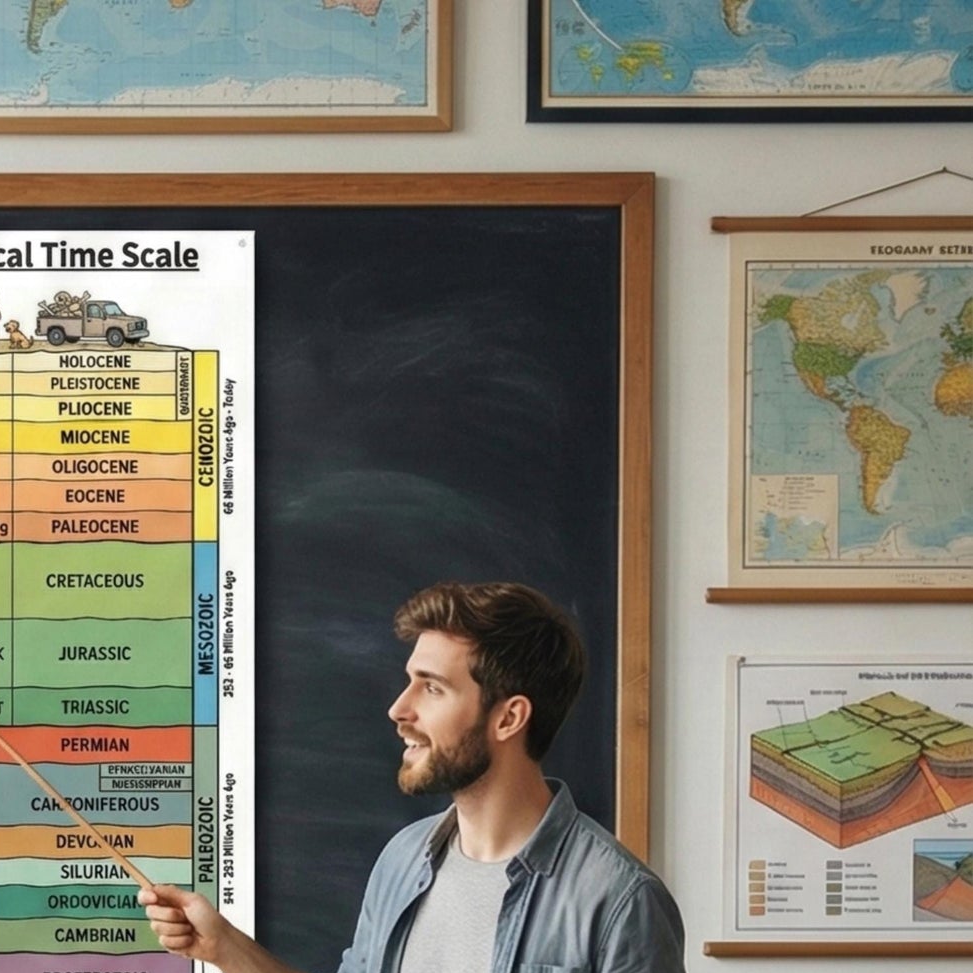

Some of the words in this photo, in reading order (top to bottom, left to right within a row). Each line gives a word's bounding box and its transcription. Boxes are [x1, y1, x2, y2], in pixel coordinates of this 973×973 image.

[40, 241, 113, 267] Time
[121, 241, 199, 267] Scale
[58, 354, 132, 369] HOLOCENE
[50, 377, 141, 391] PLEISTOCENE
[58, 401, 133, 416] PLIOCENE
[60, 429, 131, 444] MIOCENE
[52, 460, 139, 474] OLIGOCENE
[65, 489, 126, 503] EOCENE
[51, 519, 140, 534] PALEOCENE
[46, 574, 144, 588] CRETACEOUS
[198, 593, 214, 675] MESOZOIC
[59, 646, 132, 661] JURASSIC
[62, 700, 130, 714] TRIASSIC
[61, 738, 129, 752] PERMIAN
[55, 928, 136, 942] CAMBRIAN
